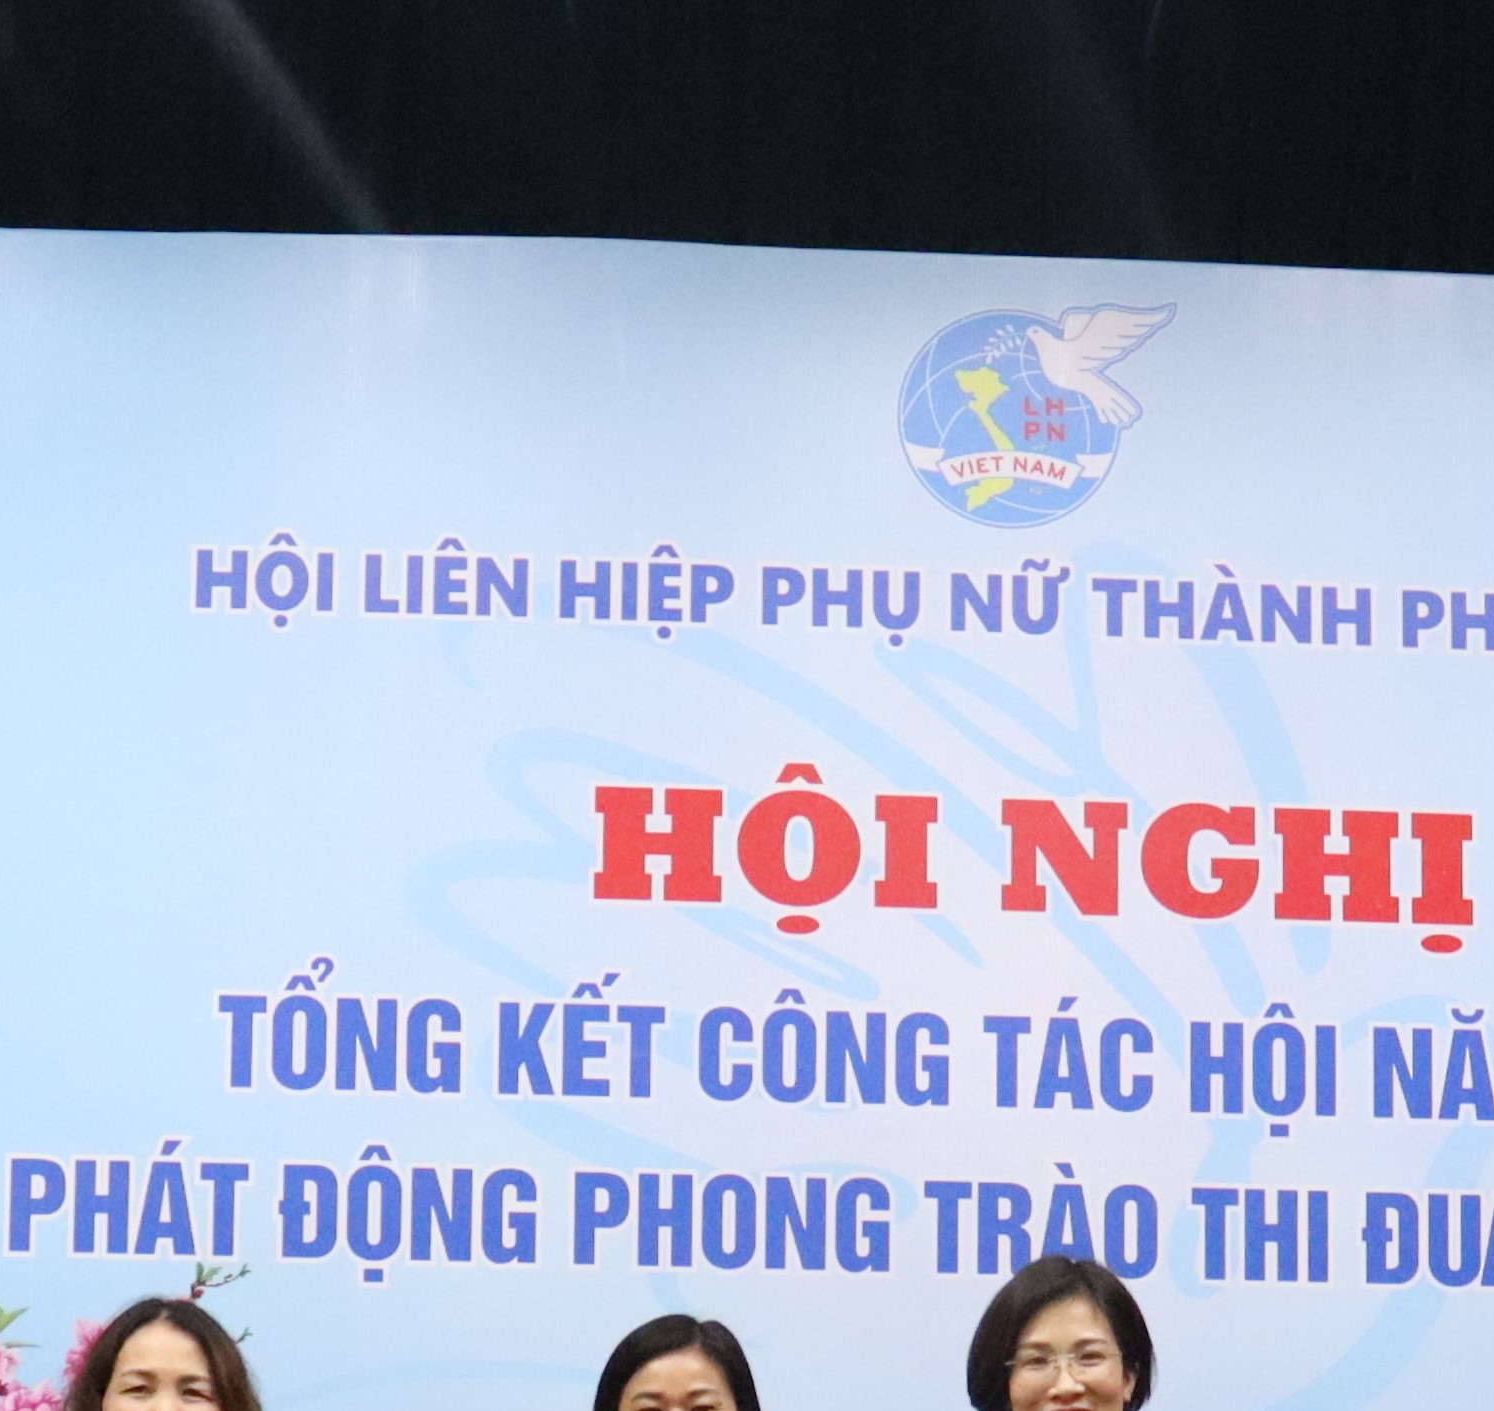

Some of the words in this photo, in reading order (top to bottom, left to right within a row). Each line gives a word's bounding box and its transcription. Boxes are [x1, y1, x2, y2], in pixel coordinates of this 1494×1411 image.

[1023, 396, 1066, 416] LH
[1024, 422, 1066, 441] PN
[950, 456, 1003, 479] VIET
[1013, 457, 1067, 480] NAM
[194, 532, 335, 628] HỘI
[364, 539, 529, 617] LIÊN
[559, 545, 735, 639] HIỆP
[762, 567, 921, 647] PHỤ
[950, 558, 1070, 634] NỮ
[1092, 565, 1372, 647] THÀNH
[594, 763, 939, 935] HỘI
[1001, 798, 1473, 954] NGHỊ
[219, 956, 462, 1093] TỔNG
[499, 972, 665, 1097] KẾT
[698, 988, 950, 1105] CÔNG
[985, 997, 1153, 1111] TÁC
[1190, 1002, 1337, 1137] HỘI
[7, 1140, 248, 1256] PHÁT
[280, 1145, 537, 1282] ĐỘNG
[573, 1171, 891, 1270] PHONG
[924, 1164, 1158, 1280] TRÀO
[1191, 1186, 1329, 1284] THI
